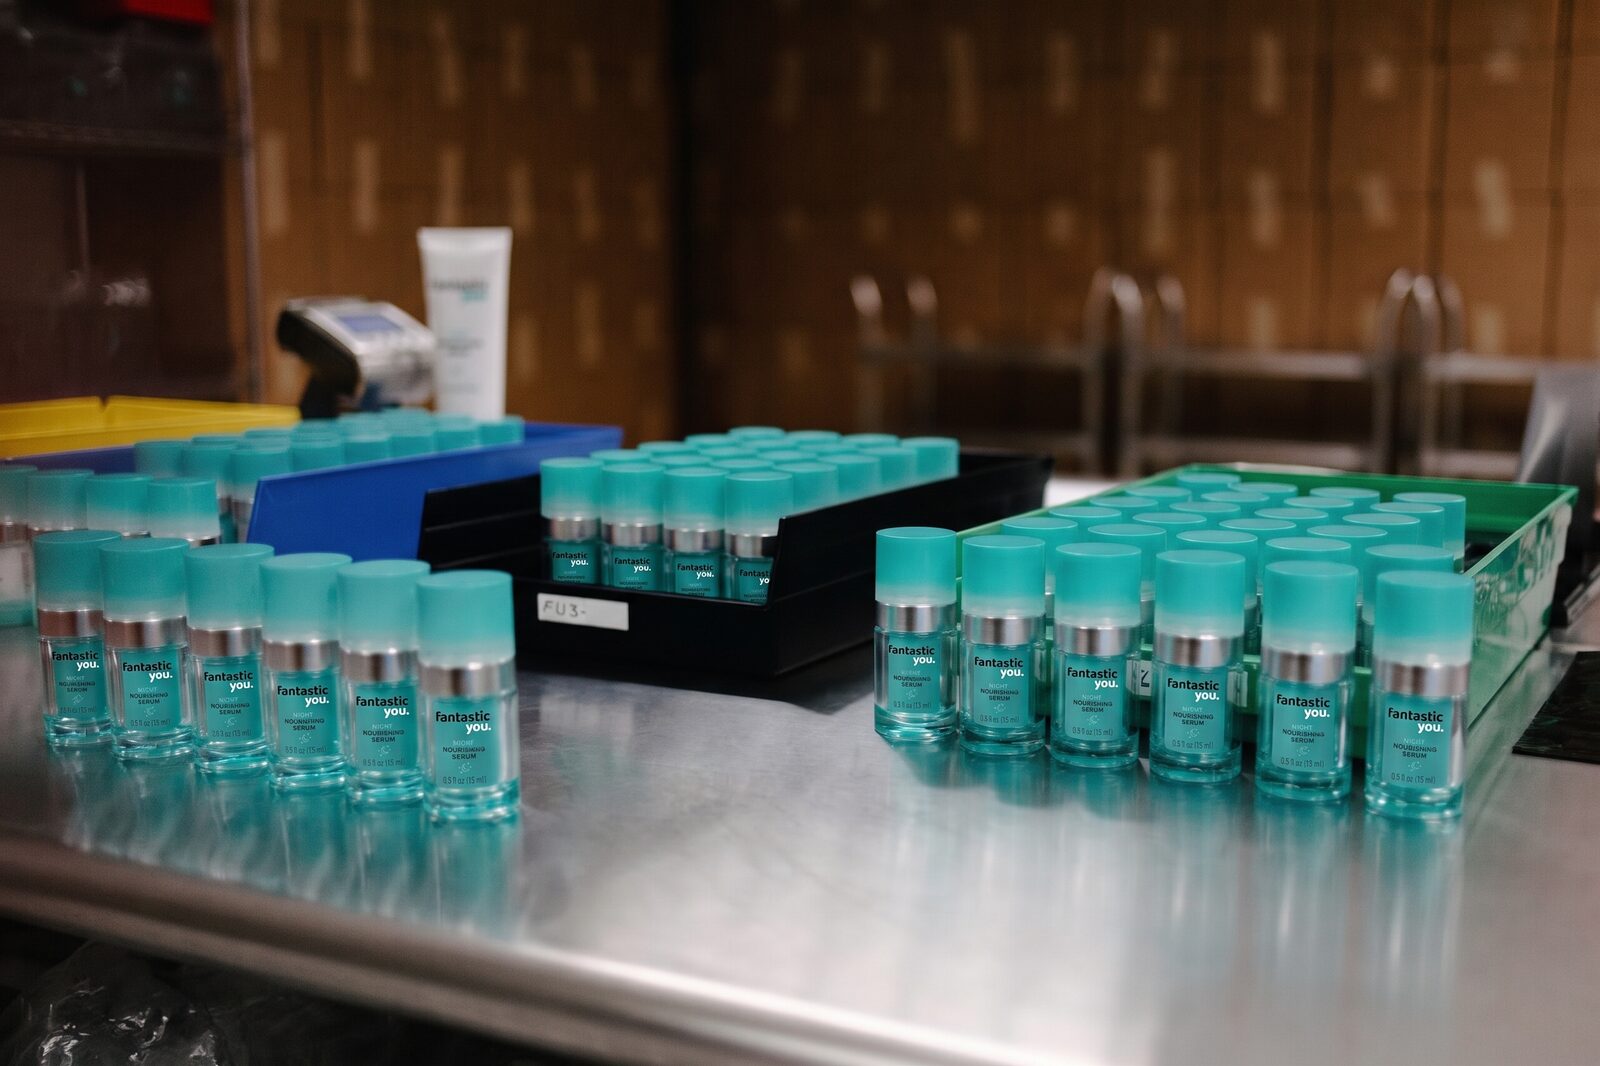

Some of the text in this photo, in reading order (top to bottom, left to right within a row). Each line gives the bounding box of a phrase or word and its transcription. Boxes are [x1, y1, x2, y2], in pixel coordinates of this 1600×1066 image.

[570, 559, 589, 568] you.
[614, 557, 650, 565] fantastic
[633, 565, 652, 574] you.
[677, 563, 714, 571] fantastic
[740, 569, 771, 577] fantast
[759, 577, 770, 586] yo
[888, 645, 936, 655] fantastic
[52, 651, 99, 661] fantastic
[912, 656, 936, 667] you.
[76, 661, 100, 671] you.
[123, 660, 173, 671] fantastic
[974, 656, 1024, 668] fantastic
[149, 671, 173, 683] you.
[204, 671, 253, 681] fantastic
[1000, 669, 1025, 680] you.
[1067, 667, 1118, 679] fantastic
[230, 681, 254, 693] you.
[1094, 680, 1119, 690] you.
[1167, 677, 1220, 691] fantastic
[277, 685, 329, 696] fantastic
[305, 696, 330, 708] you.
[356, 695, 409, 707] fantastic
[1194, 691, 1220, 703] you.
[1276, 694, 1331, 708] fantastic
[383, 707, 410, 719] you.
[436, 710, 491, 722] fantastic
[1172, 711, 1214, 720] NOURISHING
[1304, 709, 1331, 720] you.
[1388, 707, 1444, 722] fantastic
[465, 722, 492, 735] you.
[1417, 723, 1444, 734] you.
[1393, 743, 1437, 752] NOURISHING
